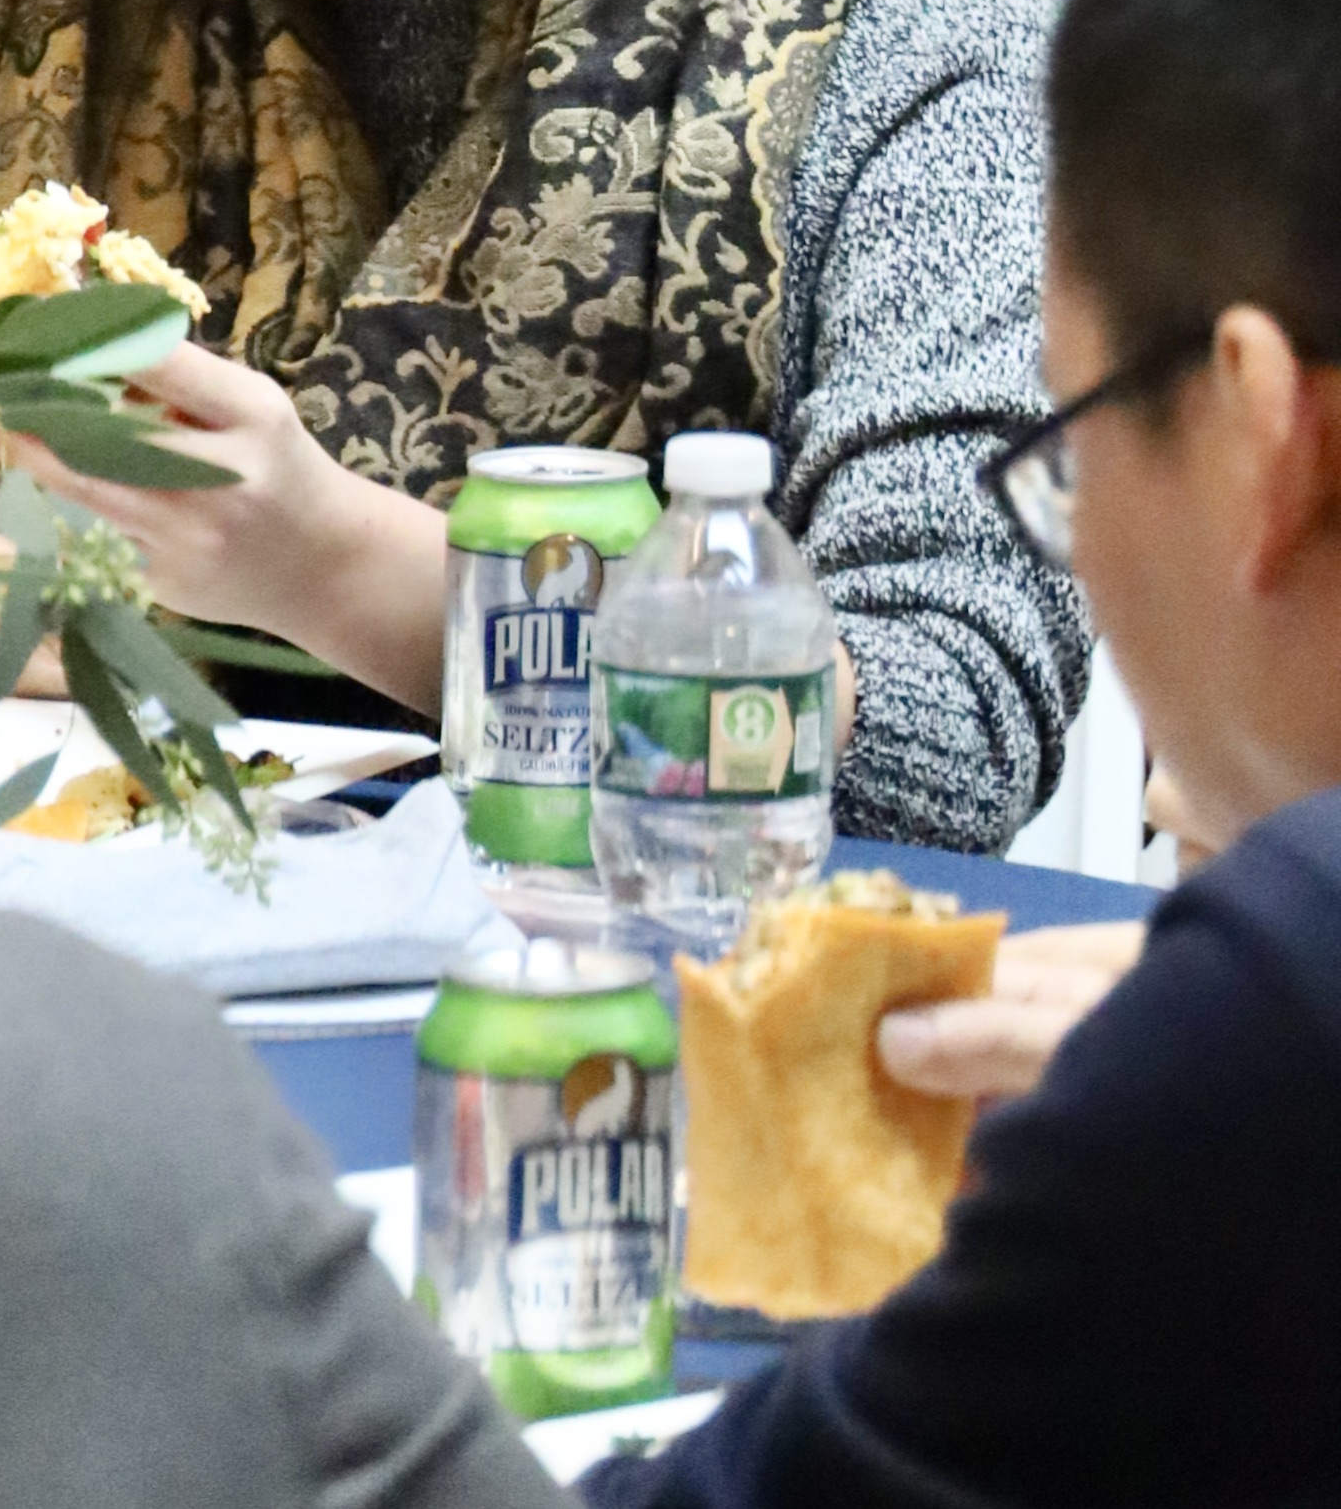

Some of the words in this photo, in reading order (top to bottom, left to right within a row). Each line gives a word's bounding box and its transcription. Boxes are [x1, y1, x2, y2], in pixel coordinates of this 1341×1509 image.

[493, 612, 592, 684] POLA
[541, 705, 591, 719] NATU
[483, 721, 590, 754] SELTZ
